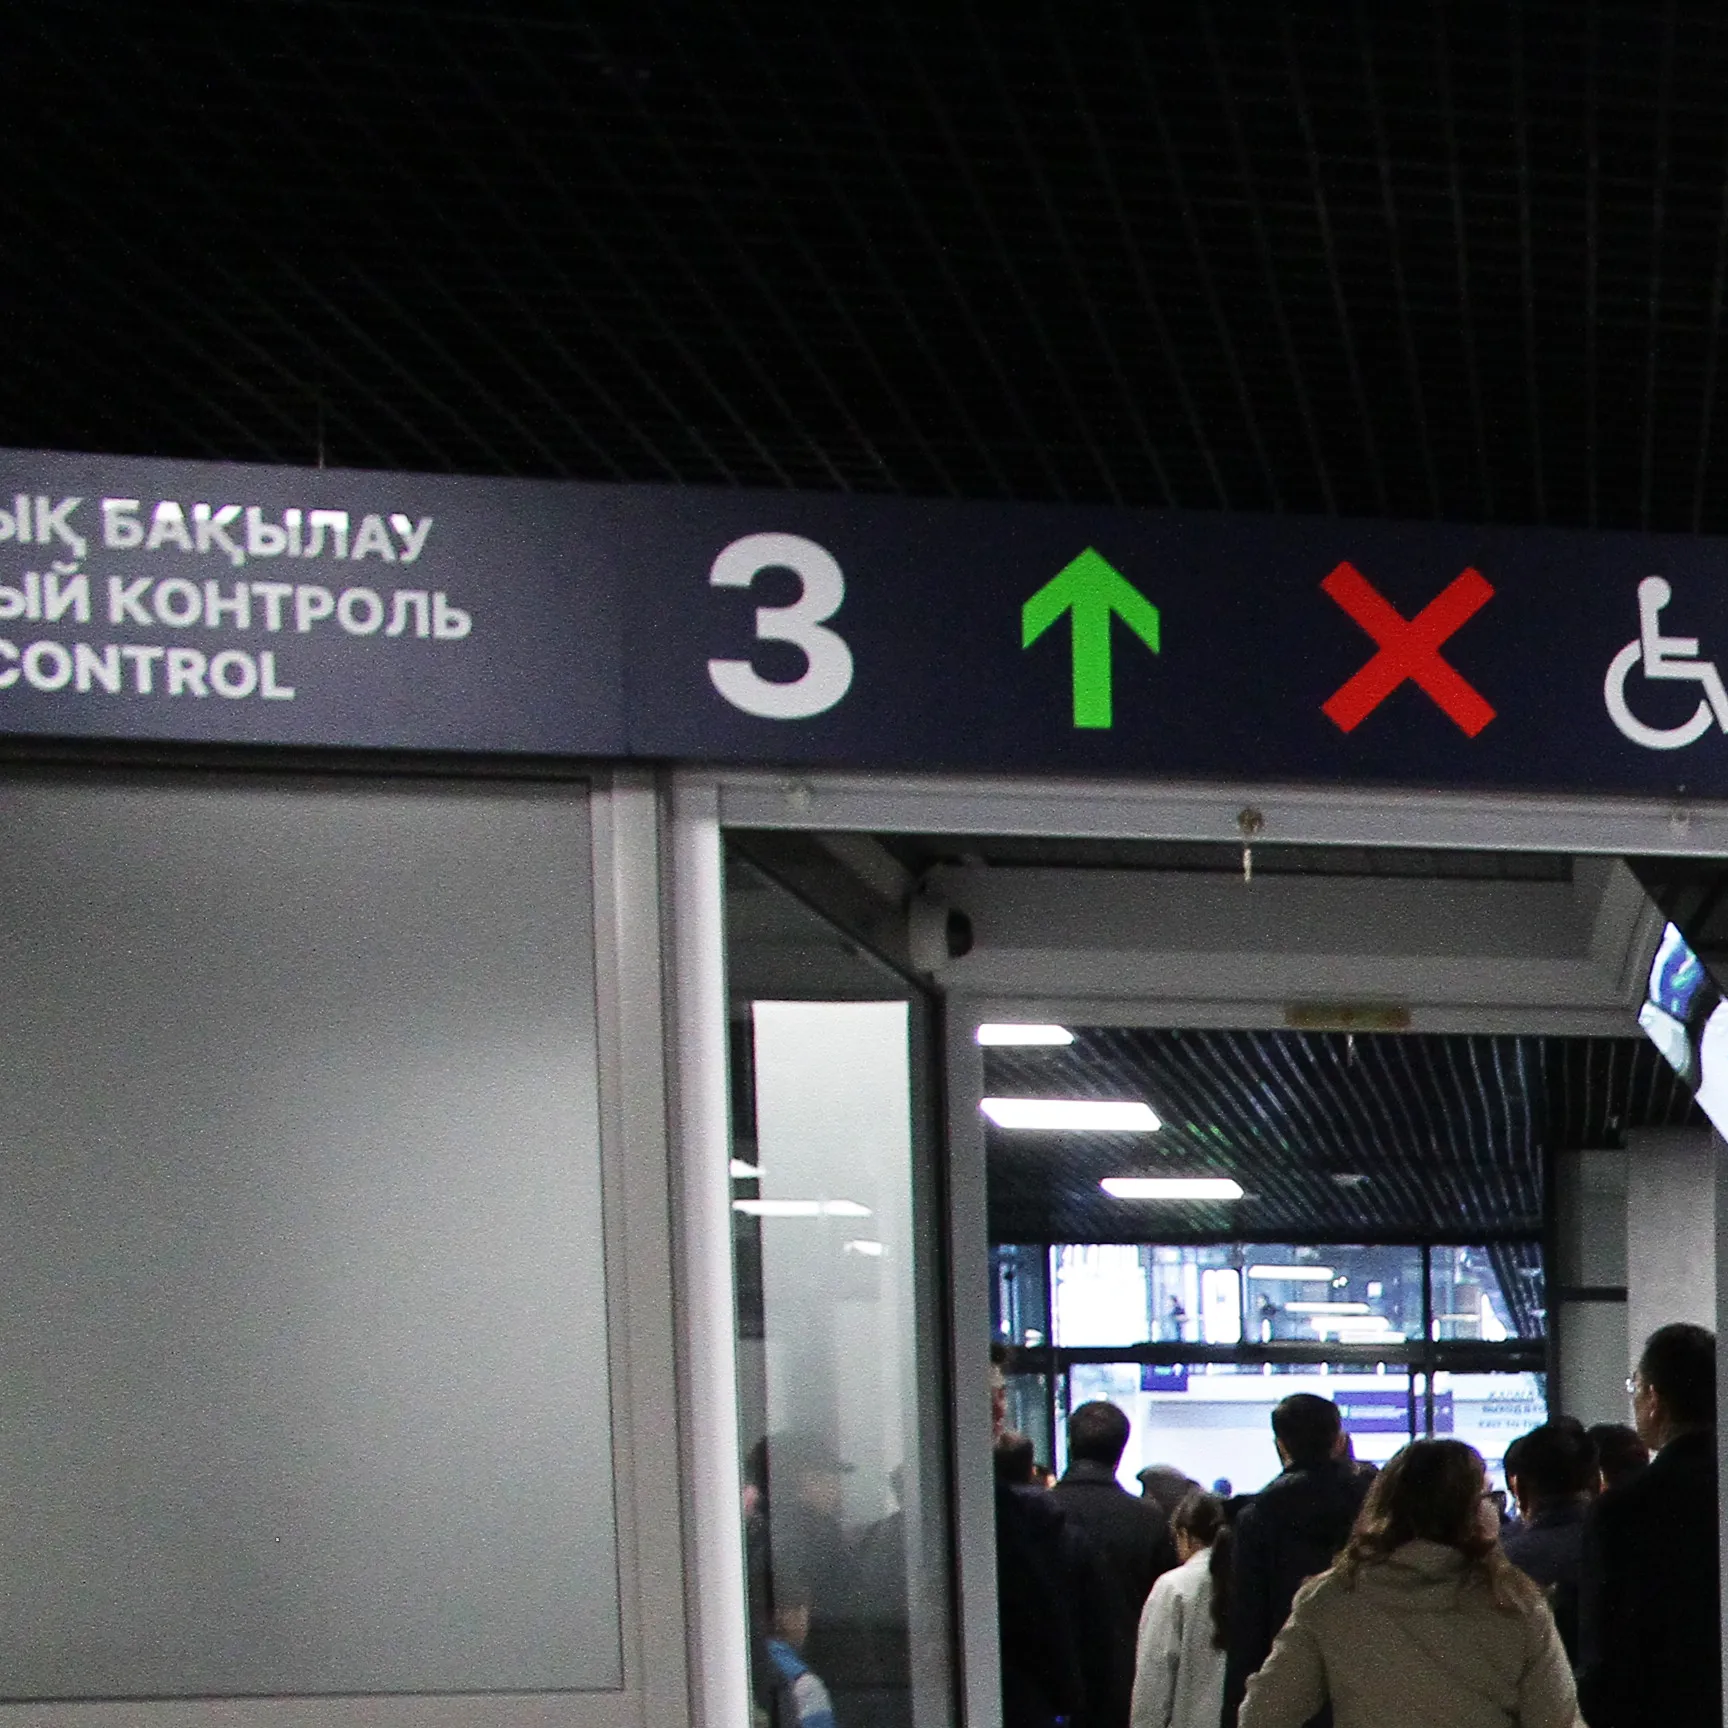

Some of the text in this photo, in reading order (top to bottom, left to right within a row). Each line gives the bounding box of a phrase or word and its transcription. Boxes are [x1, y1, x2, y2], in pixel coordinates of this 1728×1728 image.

[100, 497, 433, 566] БАҚЫЛАУ
[107, 575, 472, 640] КОНТРОЛЬ
[707, 531, 855, 721] 3
